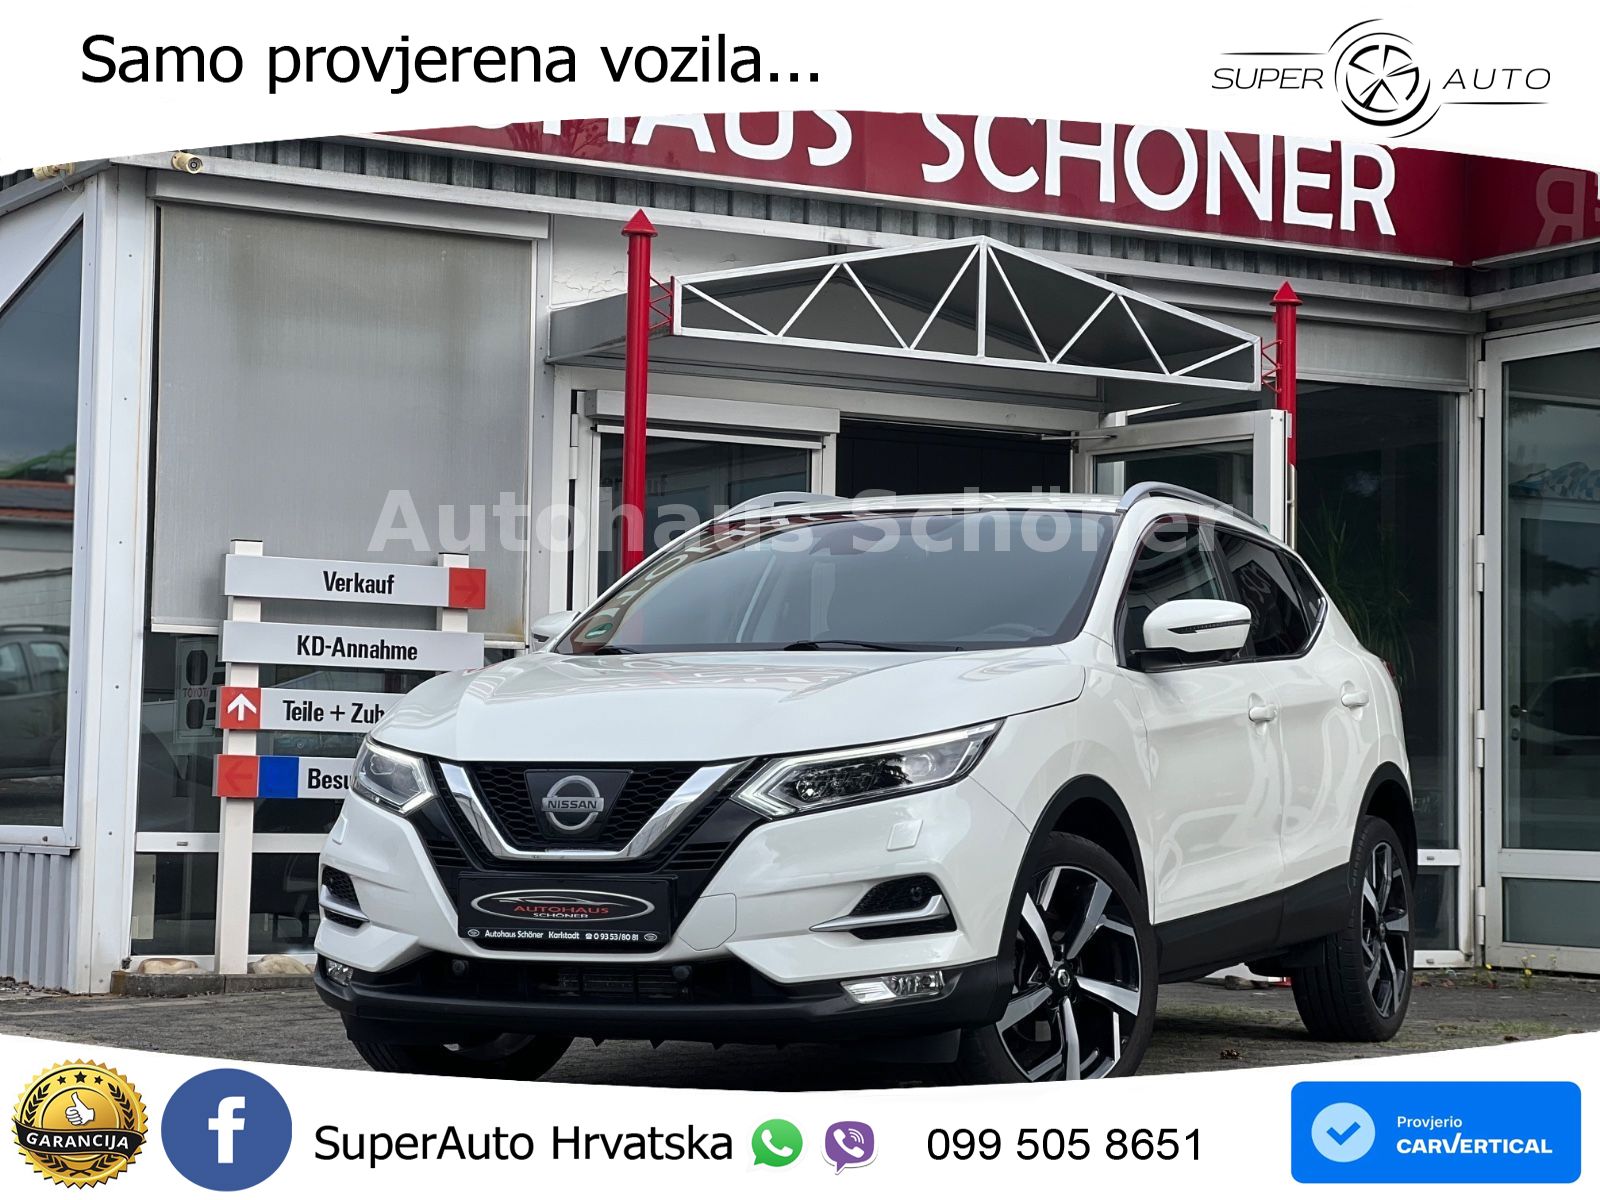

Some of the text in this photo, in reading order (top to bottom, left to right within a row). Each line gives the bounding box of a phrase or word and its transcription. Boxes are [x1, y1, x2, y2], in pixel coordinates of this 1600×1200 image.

[322, 570, 396, 595] Verkauf
[296, 634, 418, 661] KD-Annahme
[282, 700, 324, 722] Teile
[547, 800, 597, 809] NISSAN
[513, 905, 609, 914] AUTOHAUS
[533, 911, 589, 919] SCHÖNER
[484, 929, 517, 939] Autohaus
[517, 929, 544, 939] Schöner
[548, 931, 580, 940] Karlstadt
